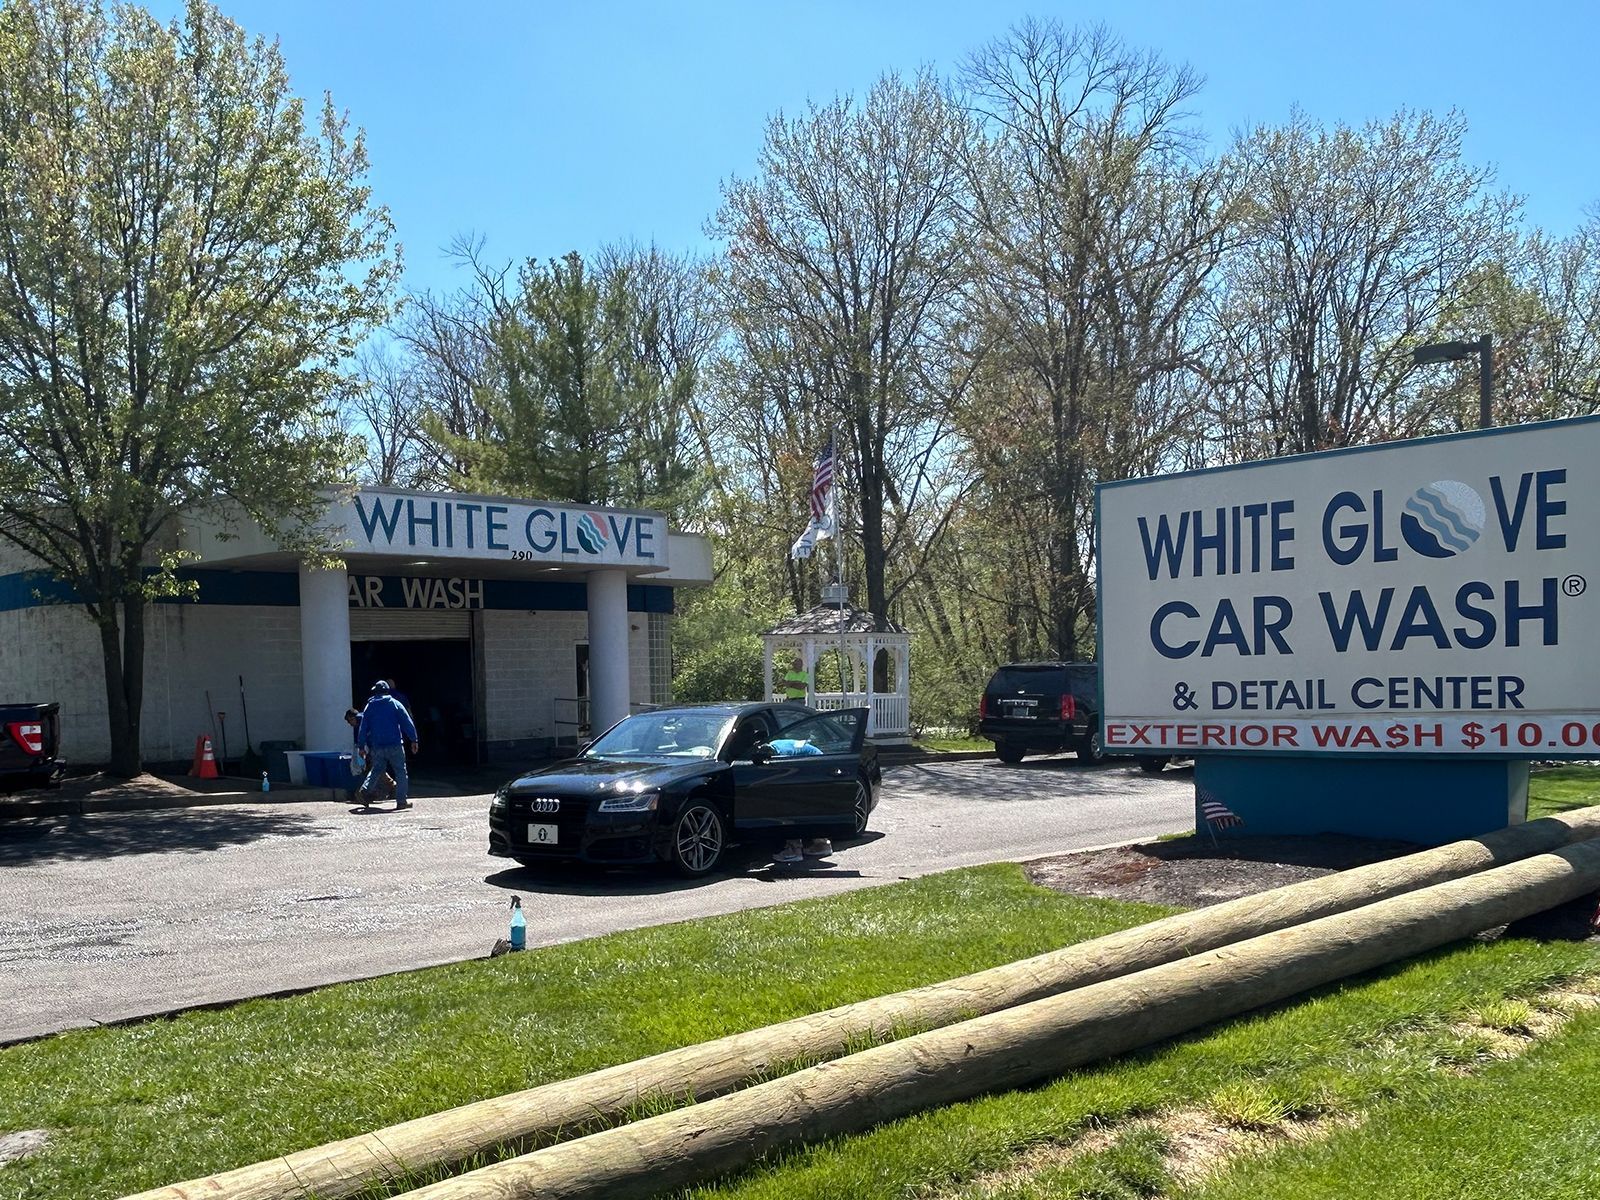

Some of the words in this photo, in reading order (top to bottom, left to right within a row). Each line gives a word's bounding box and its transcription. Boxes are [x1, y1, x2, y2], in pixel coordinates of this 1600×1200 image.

[354, 496, 509, 550] WHITE
[526, 508, 655, 558] GLOVE
[1137, 500, 1295, 580] WHITE
[1322, 469, 1567, 566] GLOVE
[511, 550, 533, 560] 290
[348, 576, 384, 608] AR
[401, 577, 484, 609] WASH
[1150, 596, 1294, 659] CAR
[1172, 681, 1199, 711] &
[1212, 679, 1336, 710] DETAIL
[1350, 676, 1526, 710] CENTER
[1106, 724, 1299, 746] EXTERIOR
[1311, 723, 1443, 749] WASH
